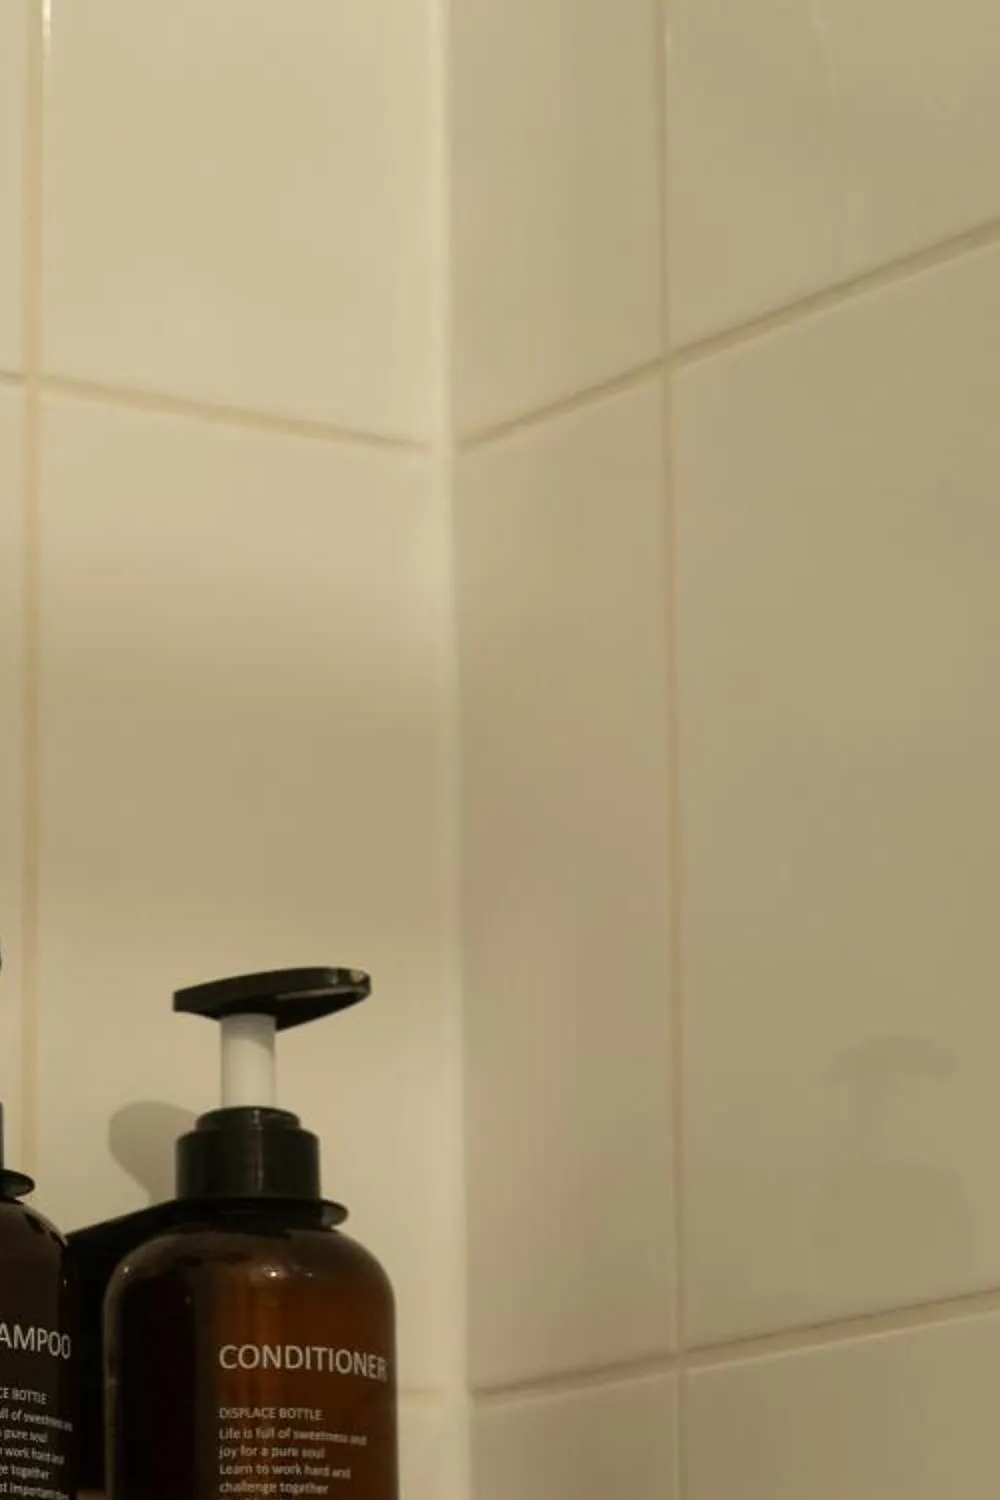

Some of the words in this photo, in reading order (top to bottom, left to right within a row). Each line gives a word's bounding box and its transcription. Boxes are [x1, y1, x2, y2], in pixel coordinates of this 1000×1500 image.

[218, 1344, 388, 1382] CONDITIONER
[11, 1409, 23, 1421] of
[219, 1407, 276, 1420] DISPLACE
[279, 1407, 323, 1421] BOTTLE
[3, 1428, 28, 1440] pure
[219, 1428, 240, 1440] Life
[243, 1427, 253, 1440] is
[255, 1427, 275, 1440] full
[277, 1427, 291, 1439] of
[5, 1446, 30, 1458] work
[240, 1444, 257, 1457] for
[261, 1447, 268, 1457] a
[271, 1446, 299, 1459] pure
[302, 1447, 325, 1460] soul
[219, 1463, 253, 1475] Learn
[256, 1464, 269, 1475] to
[272, 1463, 301, 1476] work
[304, 1465, 329, 1477] hard
[332, 1468, 351, 1480] and
[219, 1481, 277, 1495] challenge
[279, 1481, 328, 1496] together
